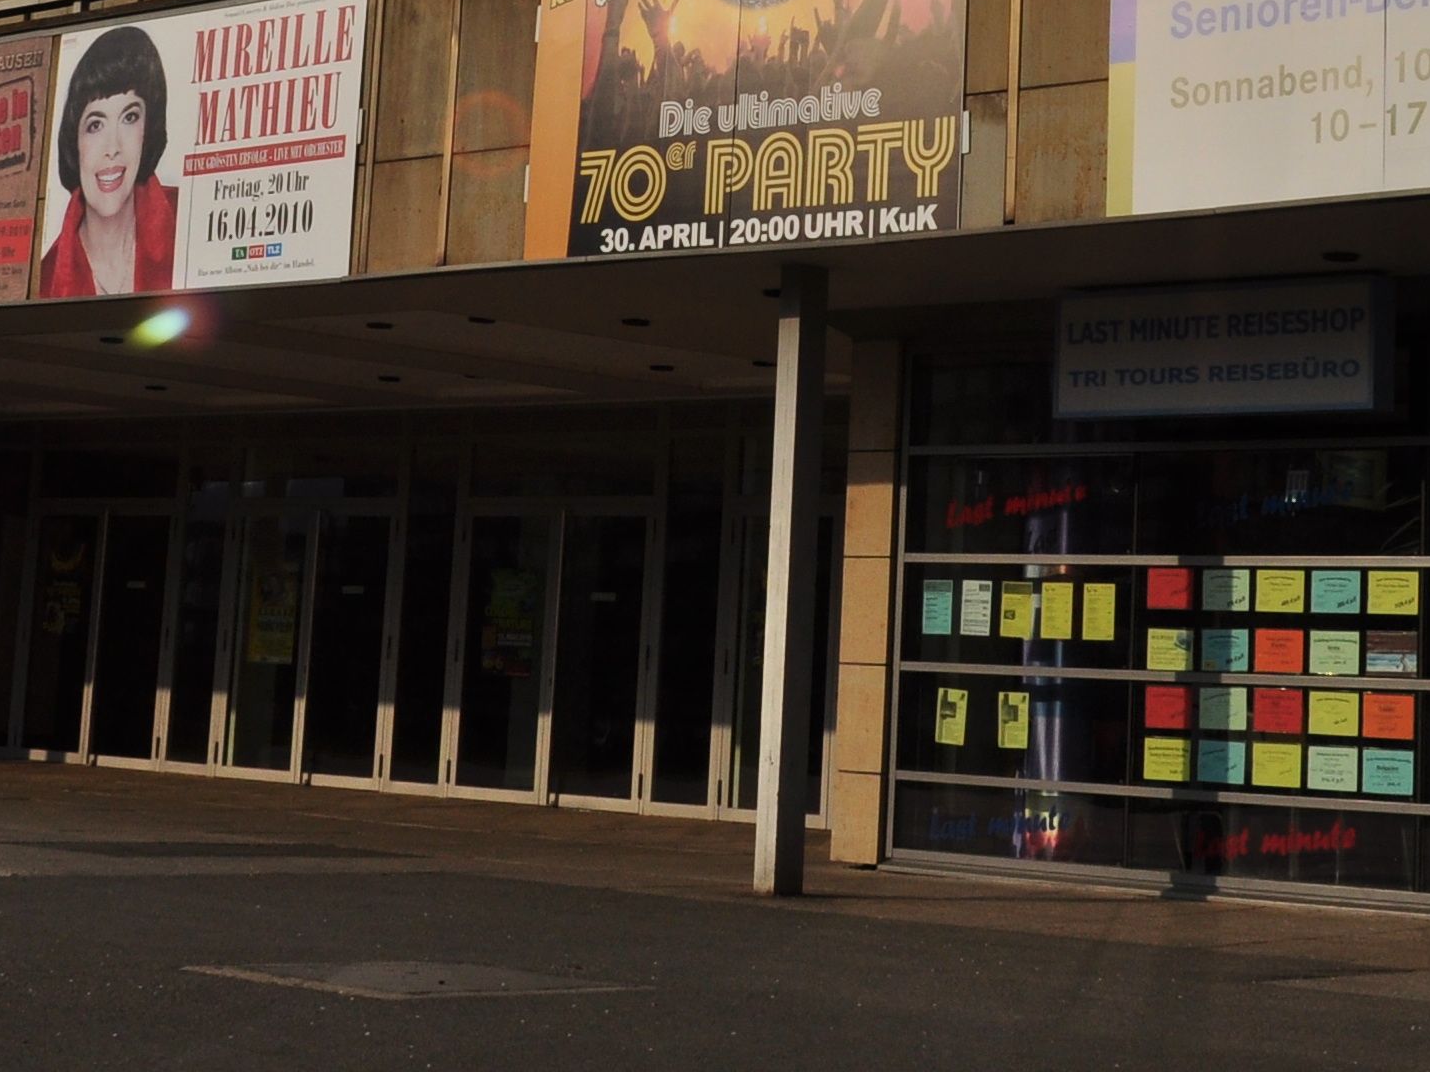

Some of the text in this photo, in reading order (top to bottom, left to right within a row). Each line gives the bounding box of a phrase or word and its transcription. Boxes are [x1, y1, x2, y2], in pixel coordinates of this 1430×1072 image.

[190, 4, 357, 84] MIREILLE
[1170, 49, 1374, 110] Sonnabend,
[195, 71, 342, 146] MATHIEU
[659, 82, 882, 138] Die ultimative
[273, 147, 289, 161] LIVE
[704, 115, 956, 215] PARTY
[213, 172, 310, 202] Freitag, 20 Uhr
[206, 199, 314, 242] 16.04.2010
[599, 226, 635, 253] 30.
[639, 220, 715, 251] APRIL
[729, 215, 800, 245] 20:00
[803, 209, 864, 238] UHR
[878, 204, 938, 234] KuK
[1068, 307, 1364, 345] LAST MINUTE REISESHOP
[1068, 357, 1361, 387] TRI TOURS REISEBÜRO
[1003, 483, 1088, 516] minute
[1260, 818, 1357, 856] minute
